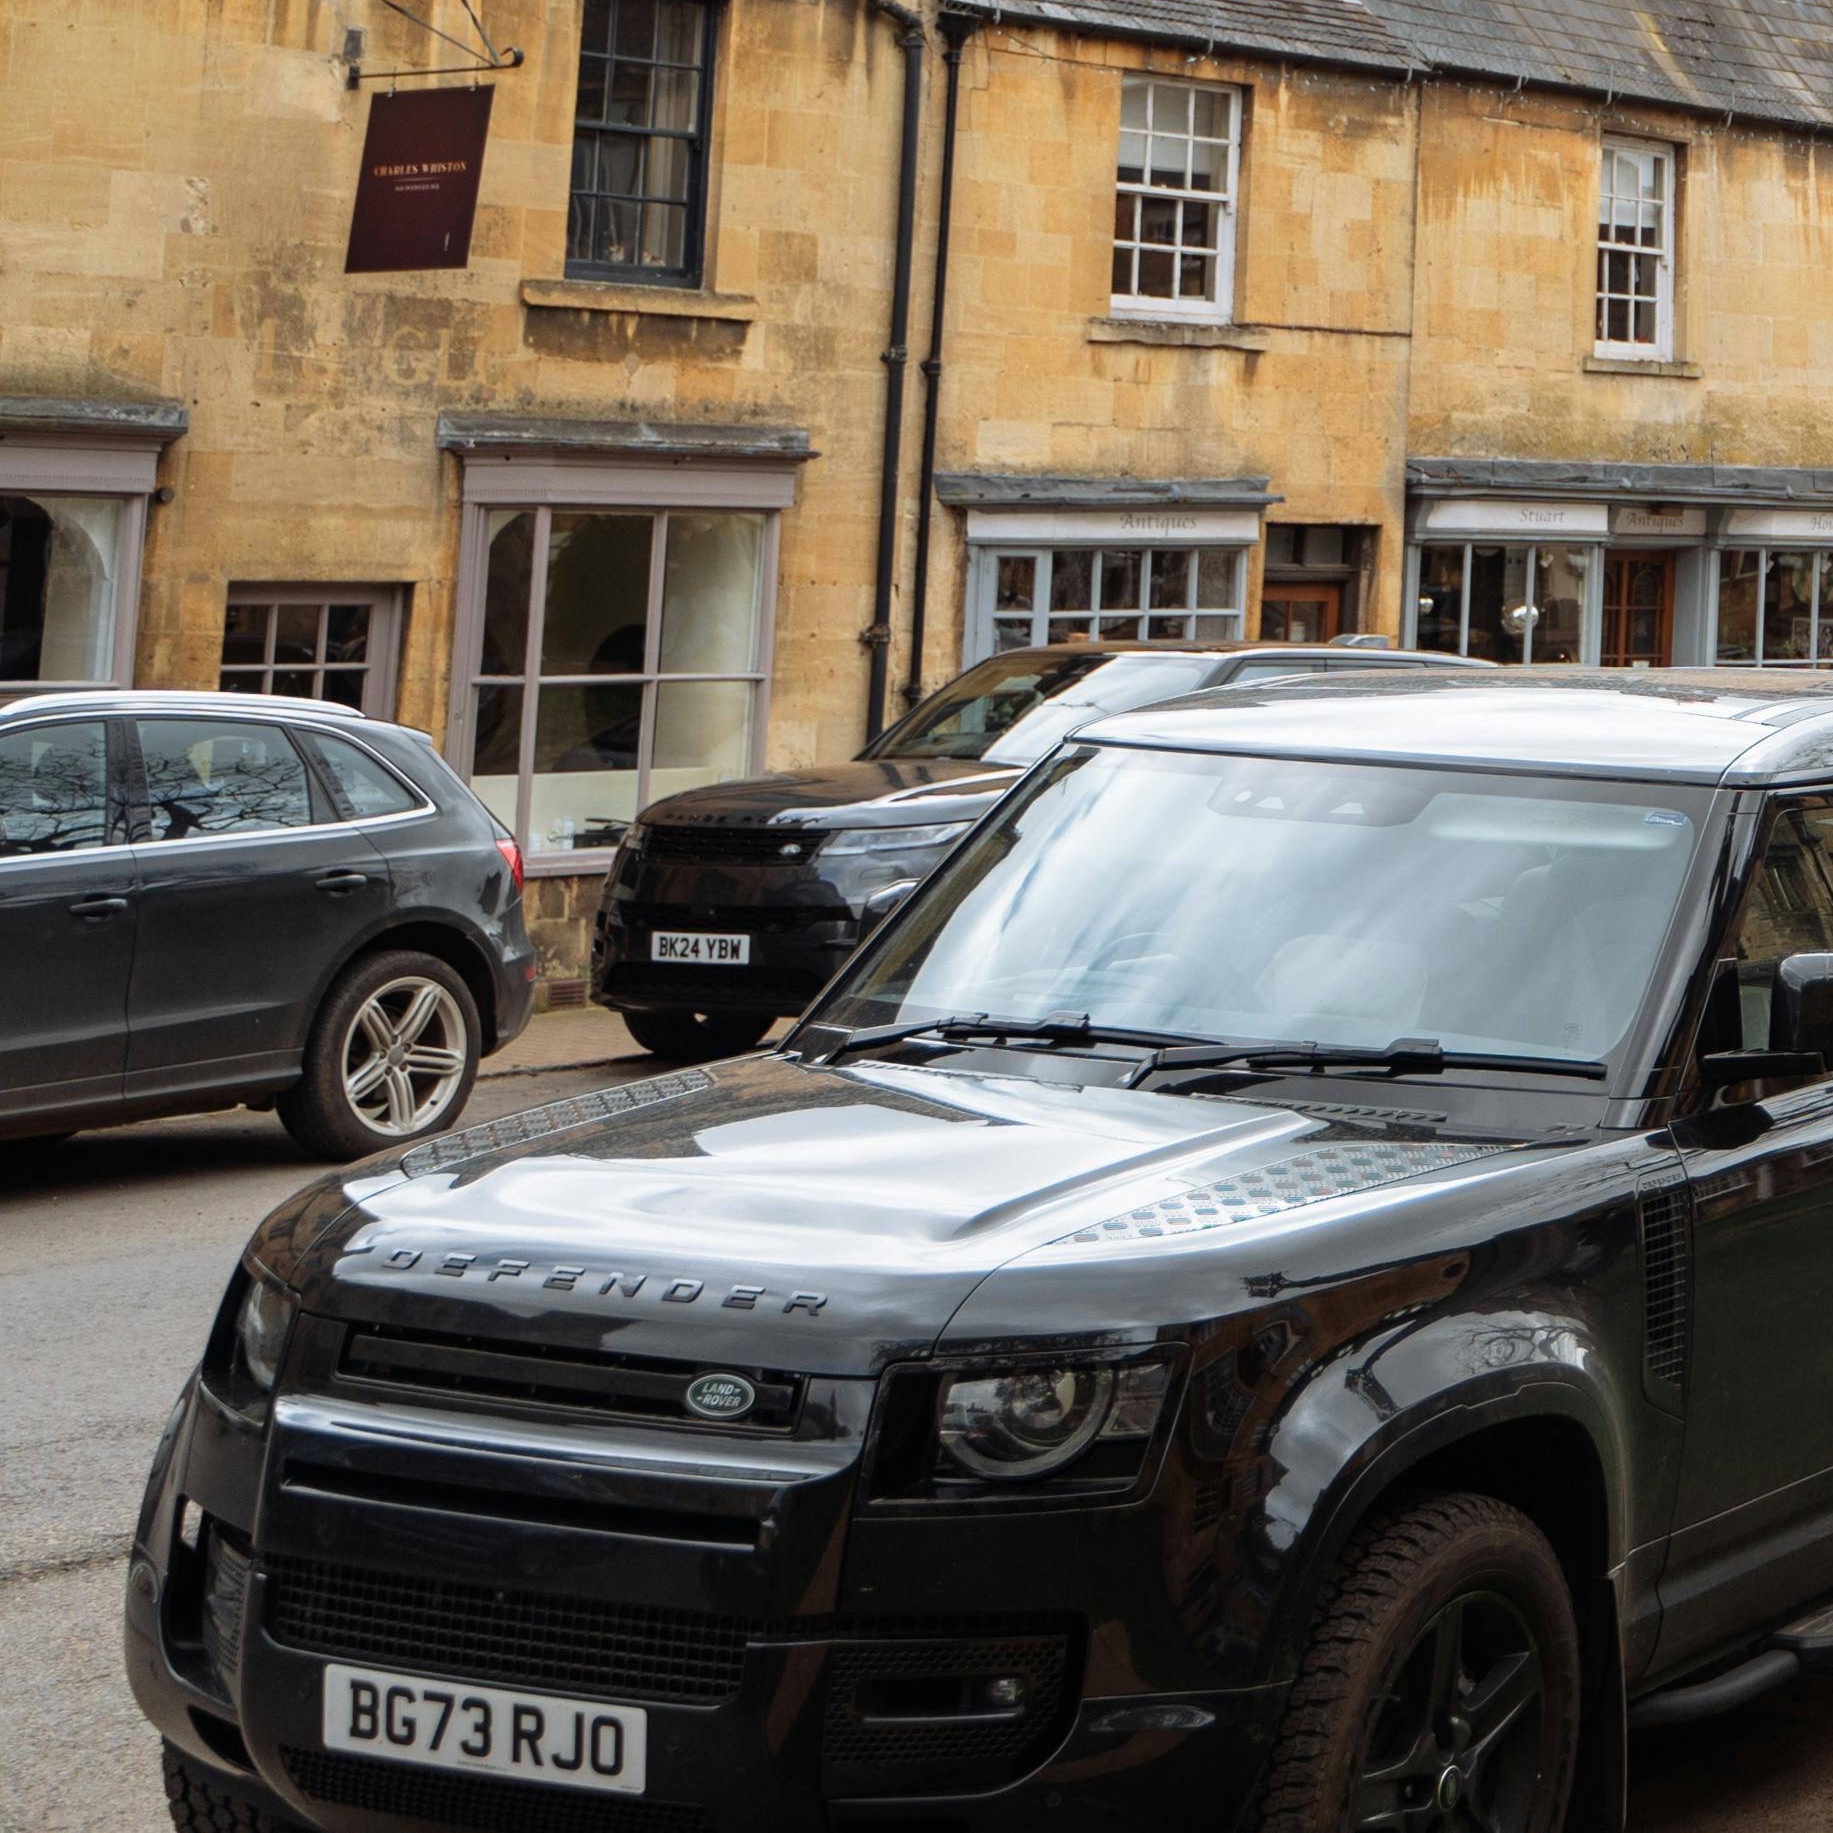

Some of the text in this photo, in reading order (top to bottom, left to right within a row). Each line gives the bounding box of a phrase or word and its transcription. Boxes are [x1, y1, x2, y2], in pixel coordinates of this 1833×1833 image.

[373, 164, 418, 176] CHARLES
[1120, 512, 1196, 536] Antiques
[1520, 508, 1565, 523] Stuart
[1625, 513, 1684, 532] Antiques
[659, 936, 741, 960] BK24 YBW
[383, 1248, 828, 1316] DEFENDER
[350, 1678, 624, 1776] BG73 RJO
